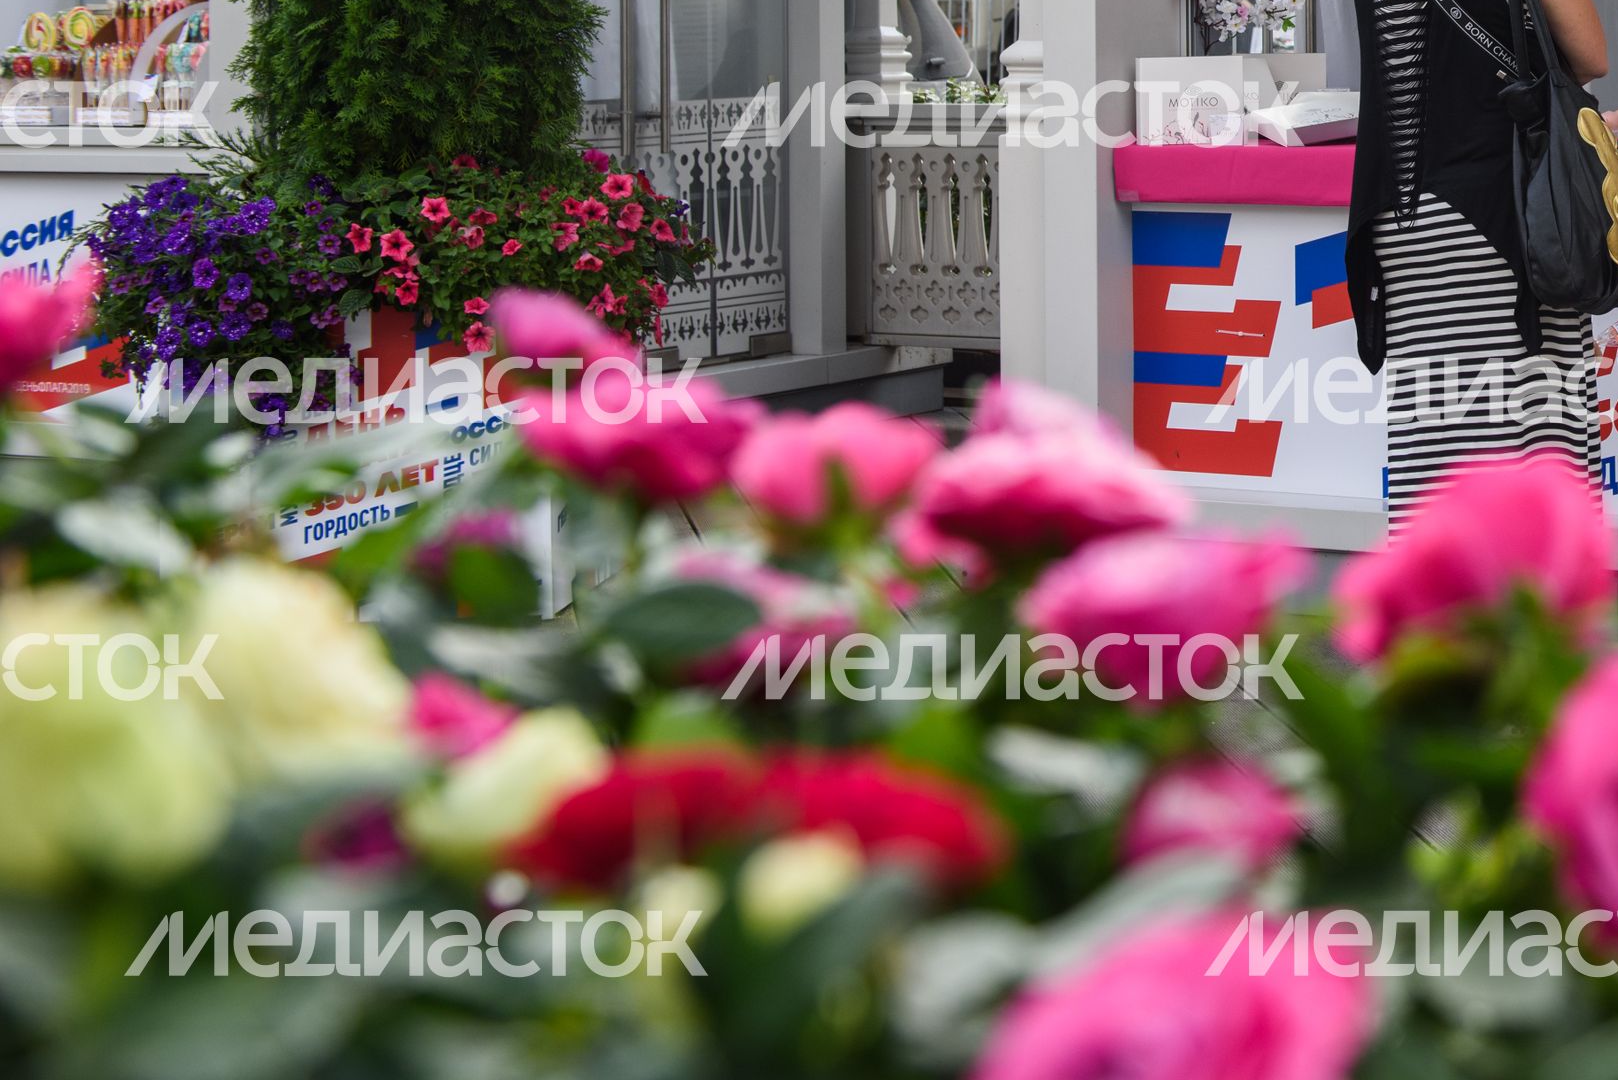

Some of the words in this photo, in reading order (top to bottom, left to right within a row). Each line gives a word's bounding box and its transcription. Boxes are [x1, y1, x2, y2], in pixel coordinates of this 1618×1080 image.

[1465, 22, 1493, 48] BORN
[1493, 46, 1519, 72] CHAM
[374, 459, 439, 498] ЛЕТ
[304, 504, 391, 544] ГОРДОСТЬ
